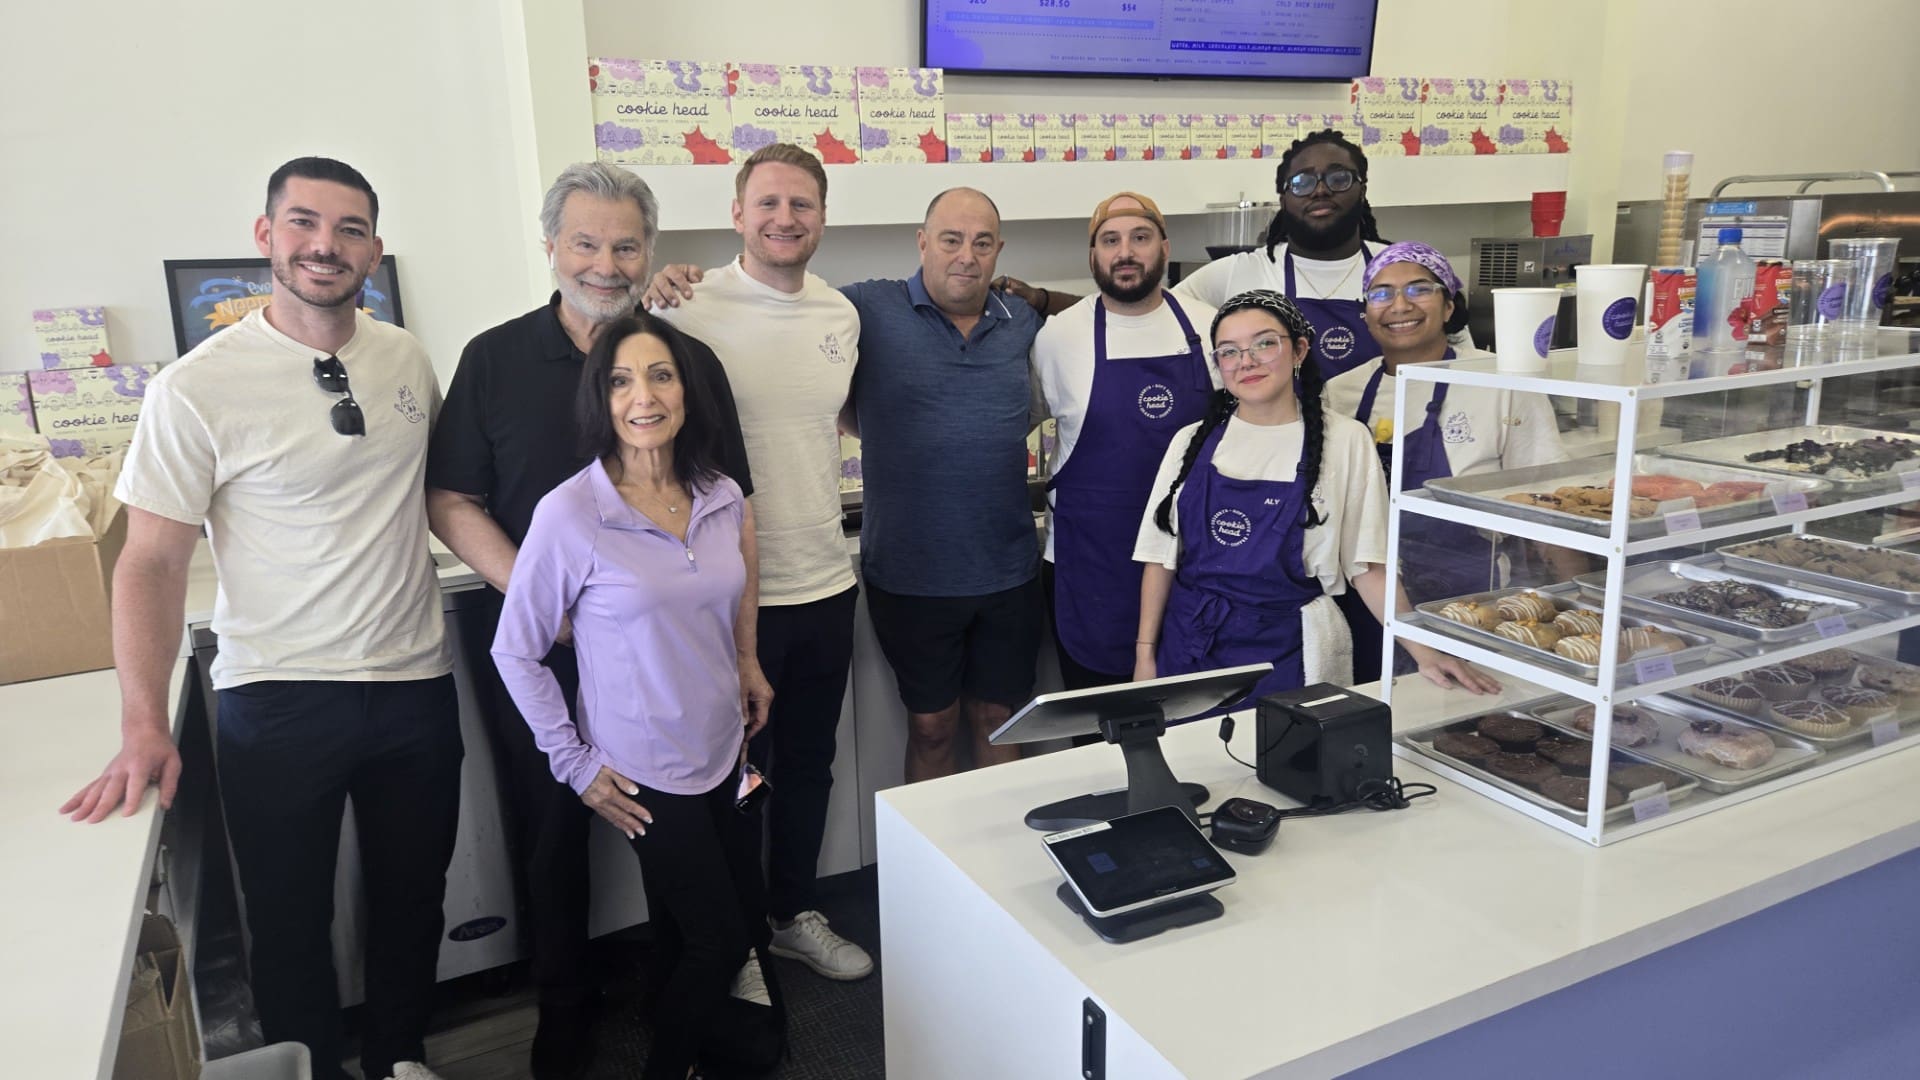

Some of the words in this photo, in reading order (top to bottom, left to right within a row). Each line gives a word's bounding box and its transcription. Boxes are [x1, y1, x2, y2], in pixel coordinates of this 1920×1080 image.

[617, 101, 668, 115] cookie
[673, 102, 709, 116] head
[754, 104, 800, 117] cookie
[805, 105, 838, 118] head
[870, 108, 905, 118] cookie
[909, 108, 936, 118] head
[1436, 111, 1464, 119] cookie
[1467, 111, 1488, 119] head
[1512, 111, 1539, 119] cookie
[52, 413, 106, 429] cookie
[112, 411, 139, 424] hea
[1216, 519, 1246, 530] cookie
[1218, 526, 1240, 537] head
